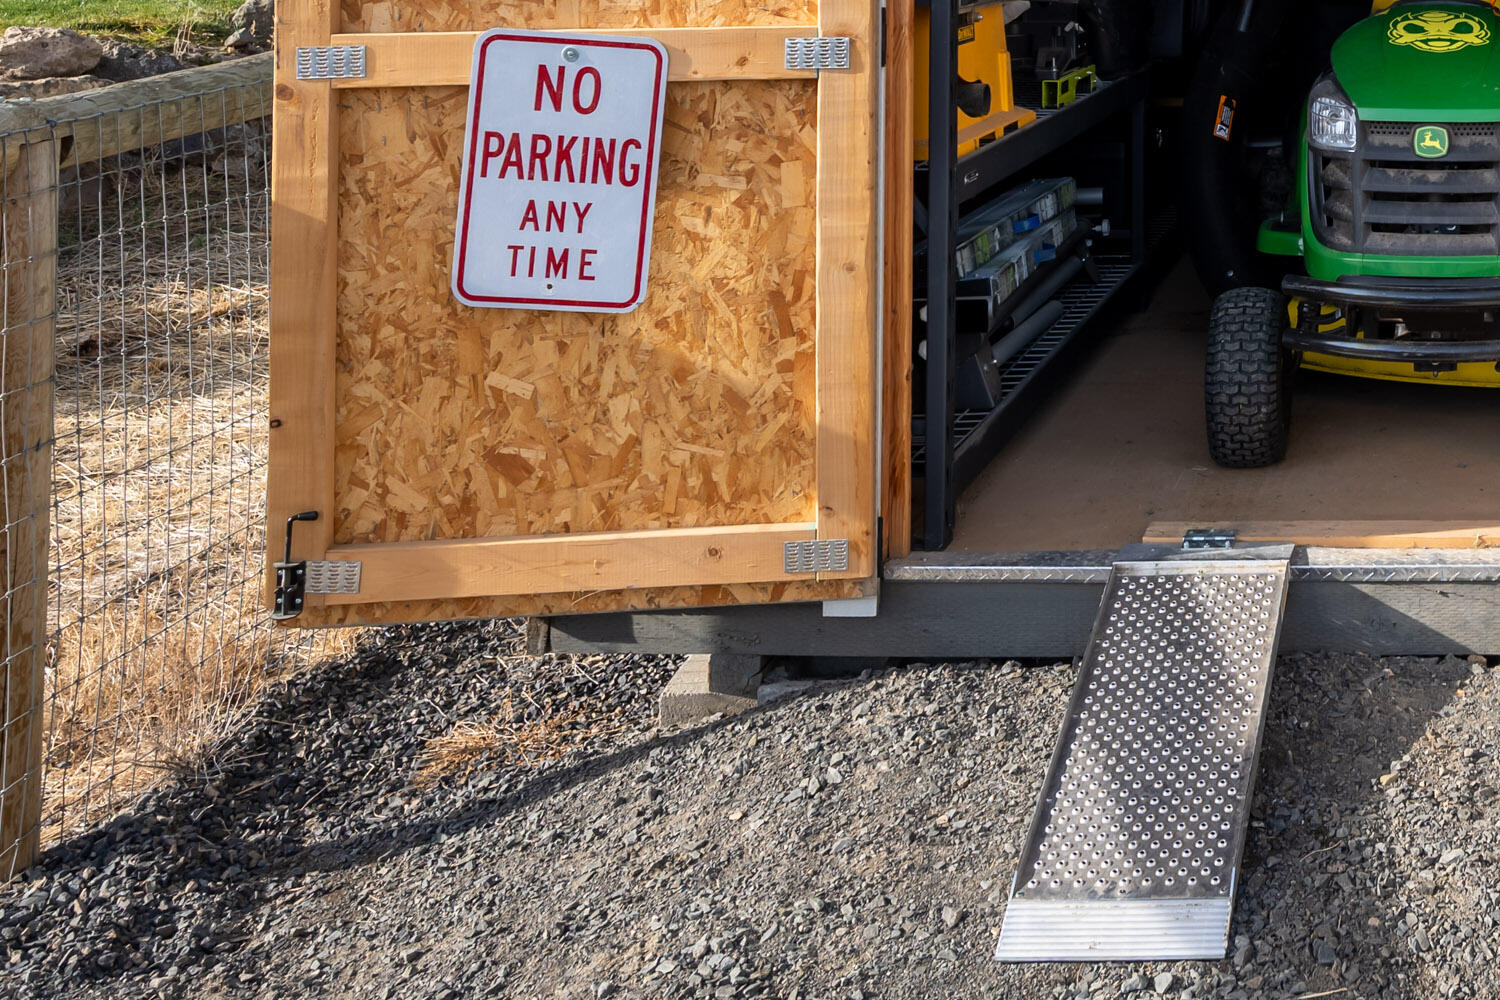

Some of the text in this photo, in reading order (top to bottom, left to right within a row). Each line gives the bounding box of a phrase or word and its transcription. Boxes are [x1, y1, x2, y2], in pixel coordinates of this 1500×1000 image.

[534, 64, 601, 115] NO
[480, 131, 642, 187] PARKING
[519, 200, 593, 234] ANY
[507, 245, 598, 281] TIME
